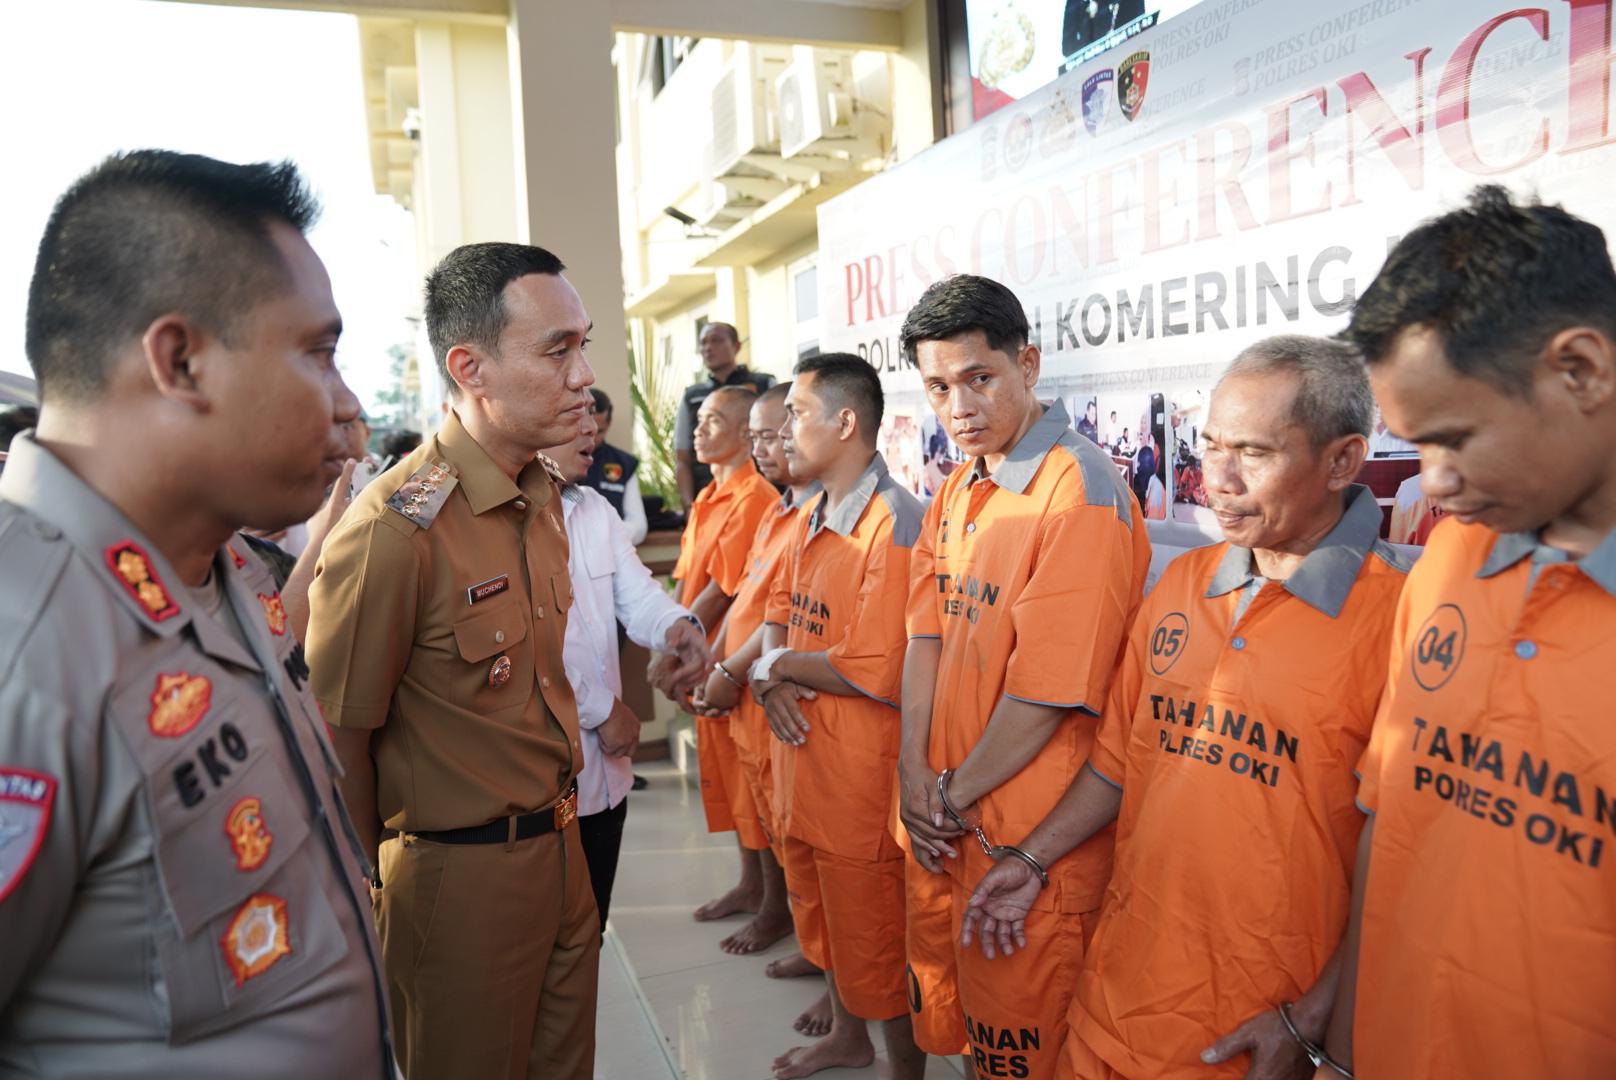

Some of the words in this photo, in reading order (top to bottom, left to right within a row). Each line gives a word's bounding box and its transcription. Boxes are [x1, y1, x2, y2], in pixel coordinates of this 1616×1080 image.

[1254, 32, 1305, 71] PRESS
[1254, 48, 1321, 92] POLRES
[1322, 33, 1358, 65] OKI
[844, 224, 957, 326] PRESS
[858, 335, 912, 374] POLR
[1056, 244, 1357, 351] KOMERING
[1153, 627, 1184, 657] 05
[1418, 626, 1457, 672] 04
[1150, 694, 1299, 764] TAHANAN
[171, 722, 250, 809] EKO
[1160, 729, 1224, 765] PLRES
[1229, 752, 1280, 788] OKI
[1524, 812, 1604, 869] OKI
[966, 1015, 1040, 1051] ANAN
[974, 1045, 1029, 1079] RES
